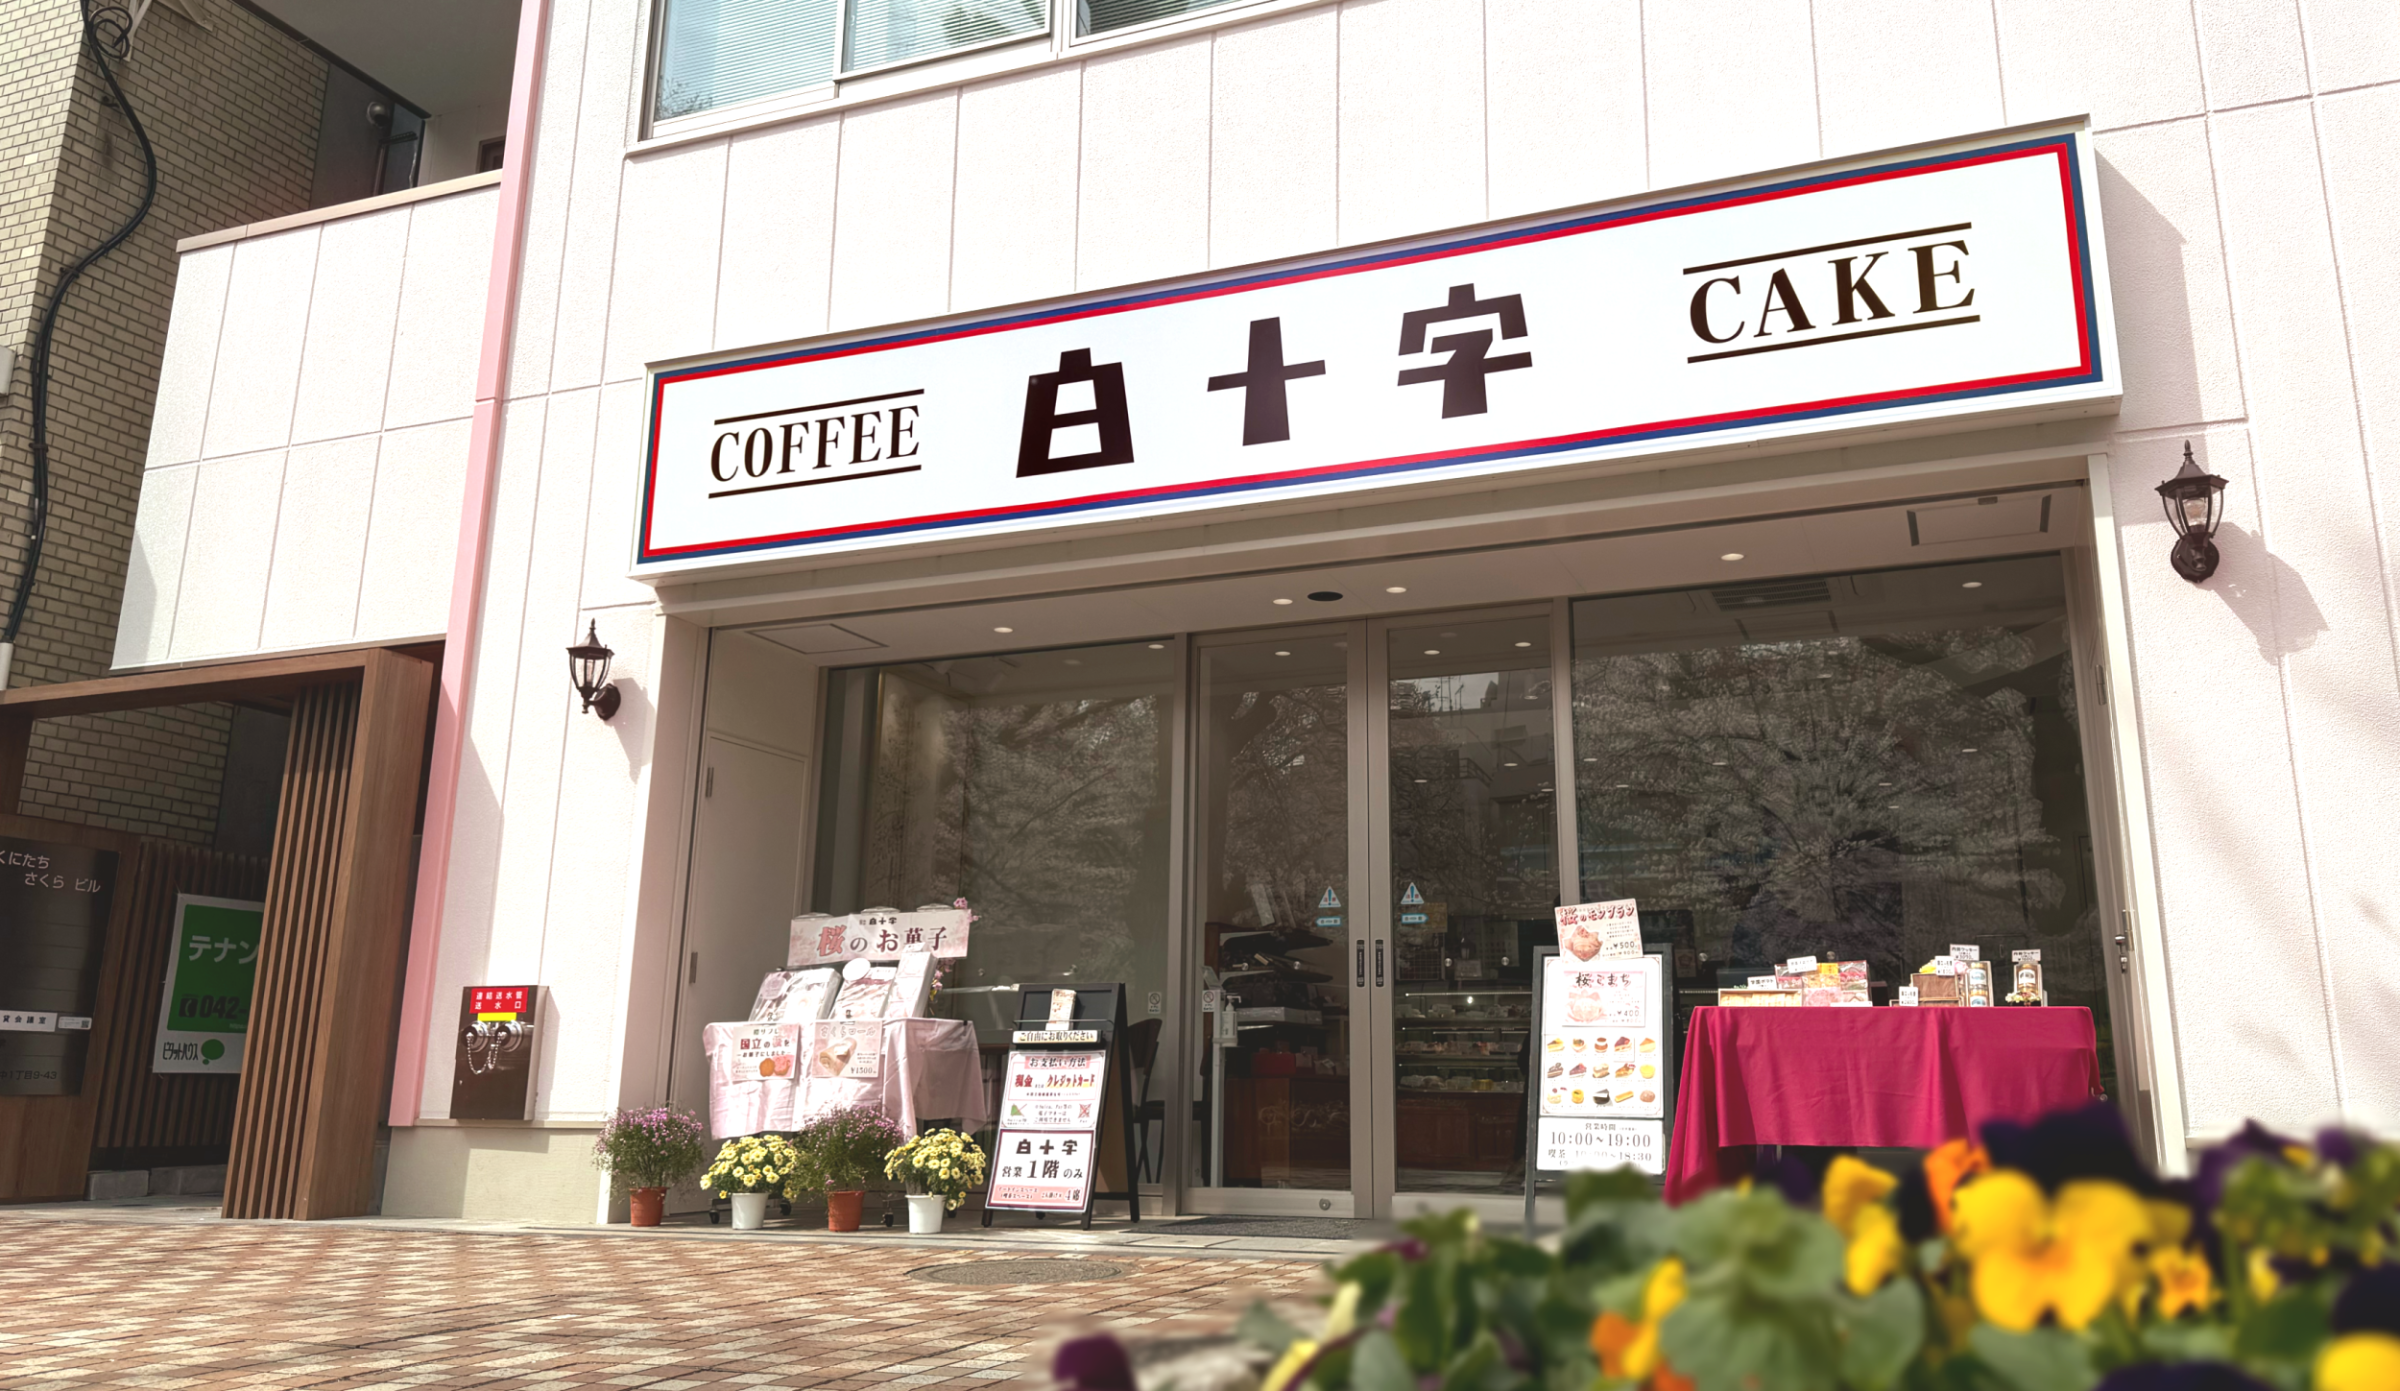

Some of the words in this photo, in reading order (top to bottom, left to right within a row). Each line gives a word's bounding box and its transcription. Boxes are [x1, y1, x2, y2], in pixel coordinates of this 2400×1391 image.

[1690, 239, 1975, 343] CAKE
[1016, 283, 1532, 478] 白十字
[710, 405, 920, 482] COFFEE
[0, 850, 50, 869] くにたち
[25, 872, 64, 889] さくら
[75, 878, 101, 893] ビル
[188, 935, 259, 964] テナン
[818, 924, 947, 957] 桜のお菓子
[1576, 972, 1631, 987] 桜こまち
[1020, 1032, 1094, 1042] ご自由にお取りください
[1030, 1057, 1086, 1068] お支払い方法
[1016, 1138, 1078, 1155] 白十字
